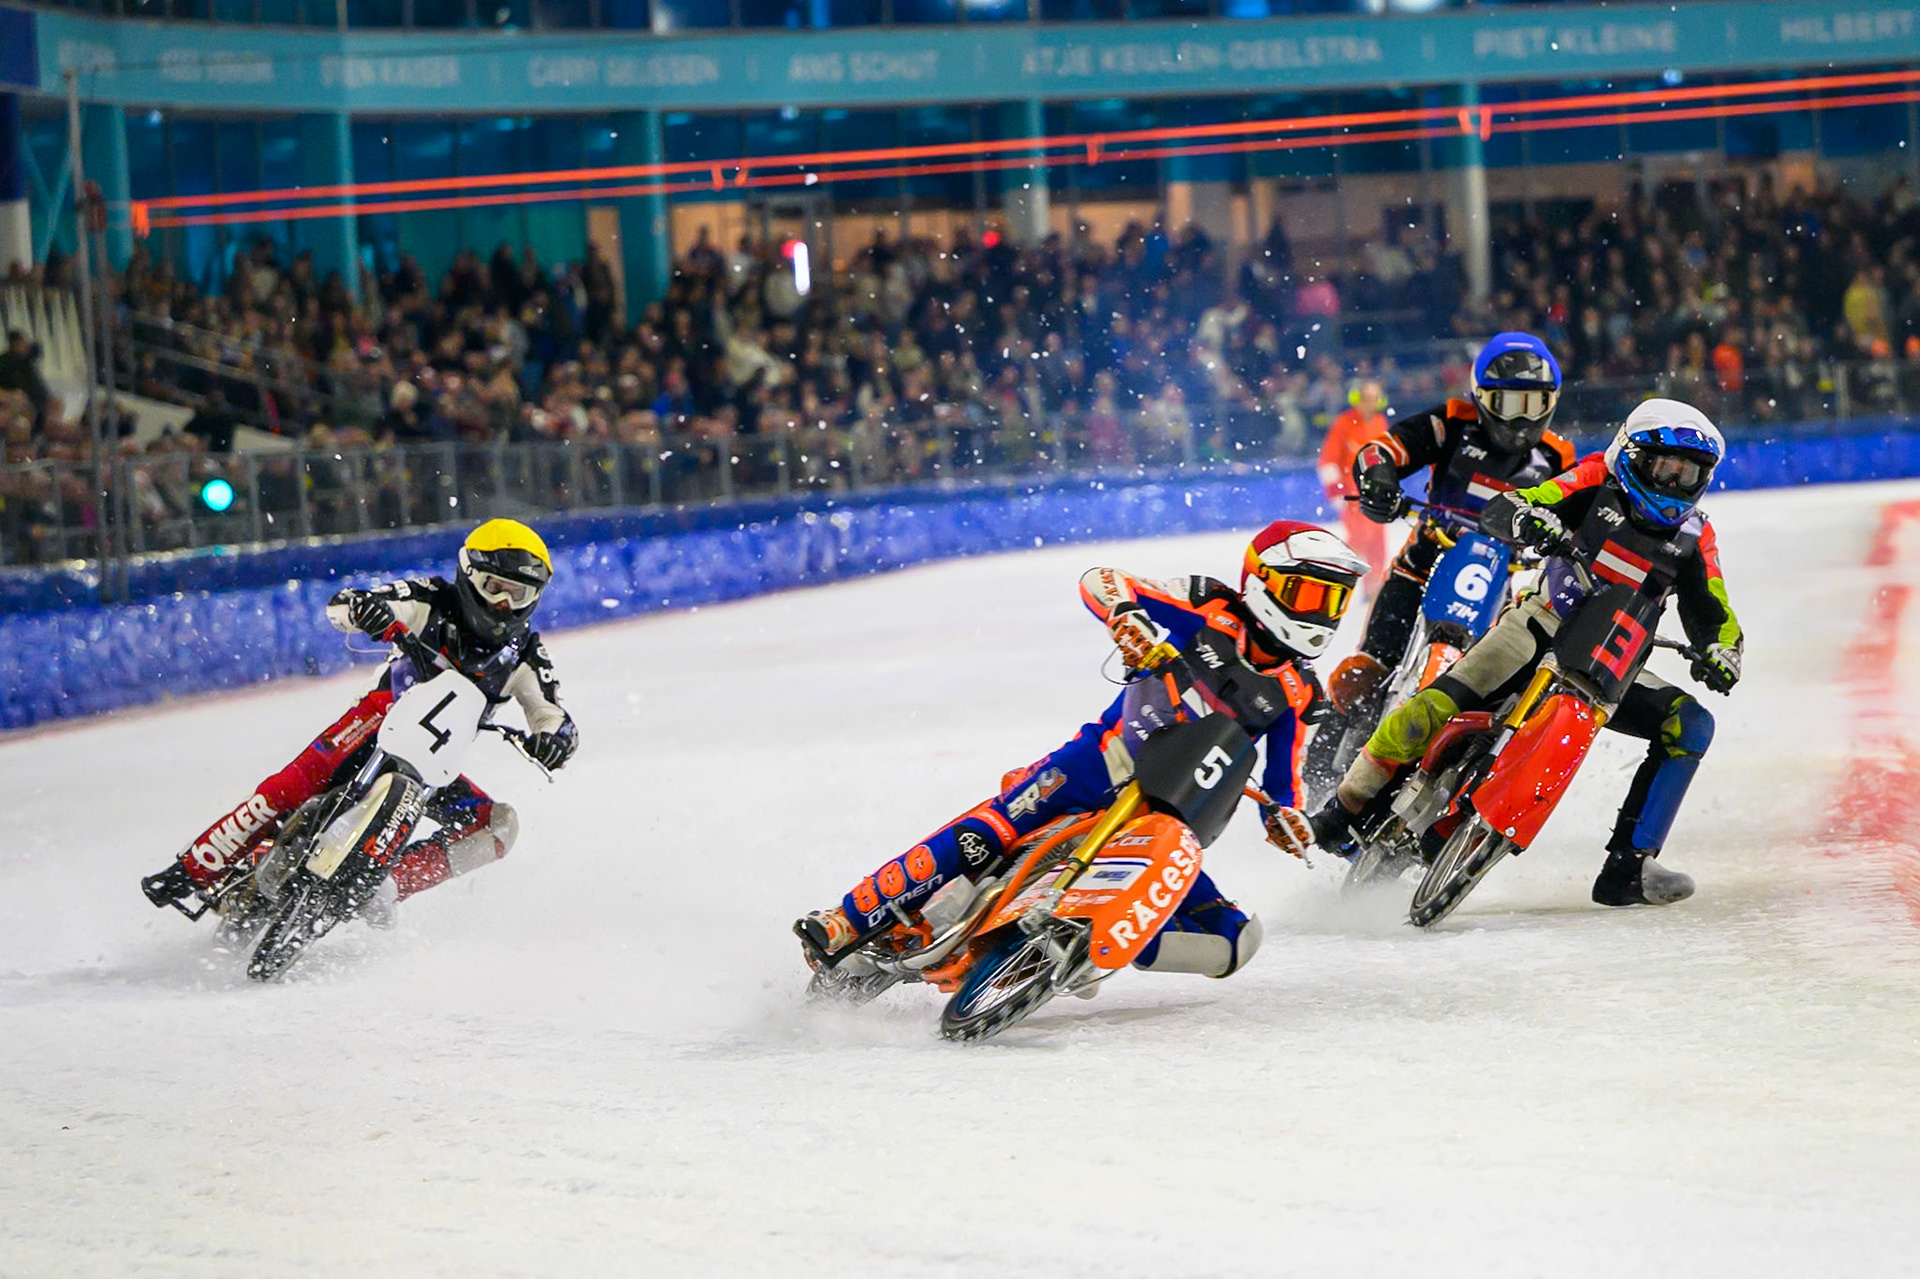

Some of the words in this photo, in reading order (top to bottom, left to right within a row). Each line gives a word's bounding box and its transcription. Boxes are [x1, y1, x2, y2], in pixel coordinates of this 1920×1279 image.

[1473, 27, 1546, 58] PIET
[1555, 21, 1677, 55] KLEINE
[1598, 506, 1625, 527] FIM
[1454, 563, 1493, 601] 6
[1446, 601, 1480, 622] FIM
[1195, 644, 1224, 670] FIM
[1591, 609, 1648, 682] 3
[419, 690, 458, 755] 4
[1194, 745, 1233, 789] 5
